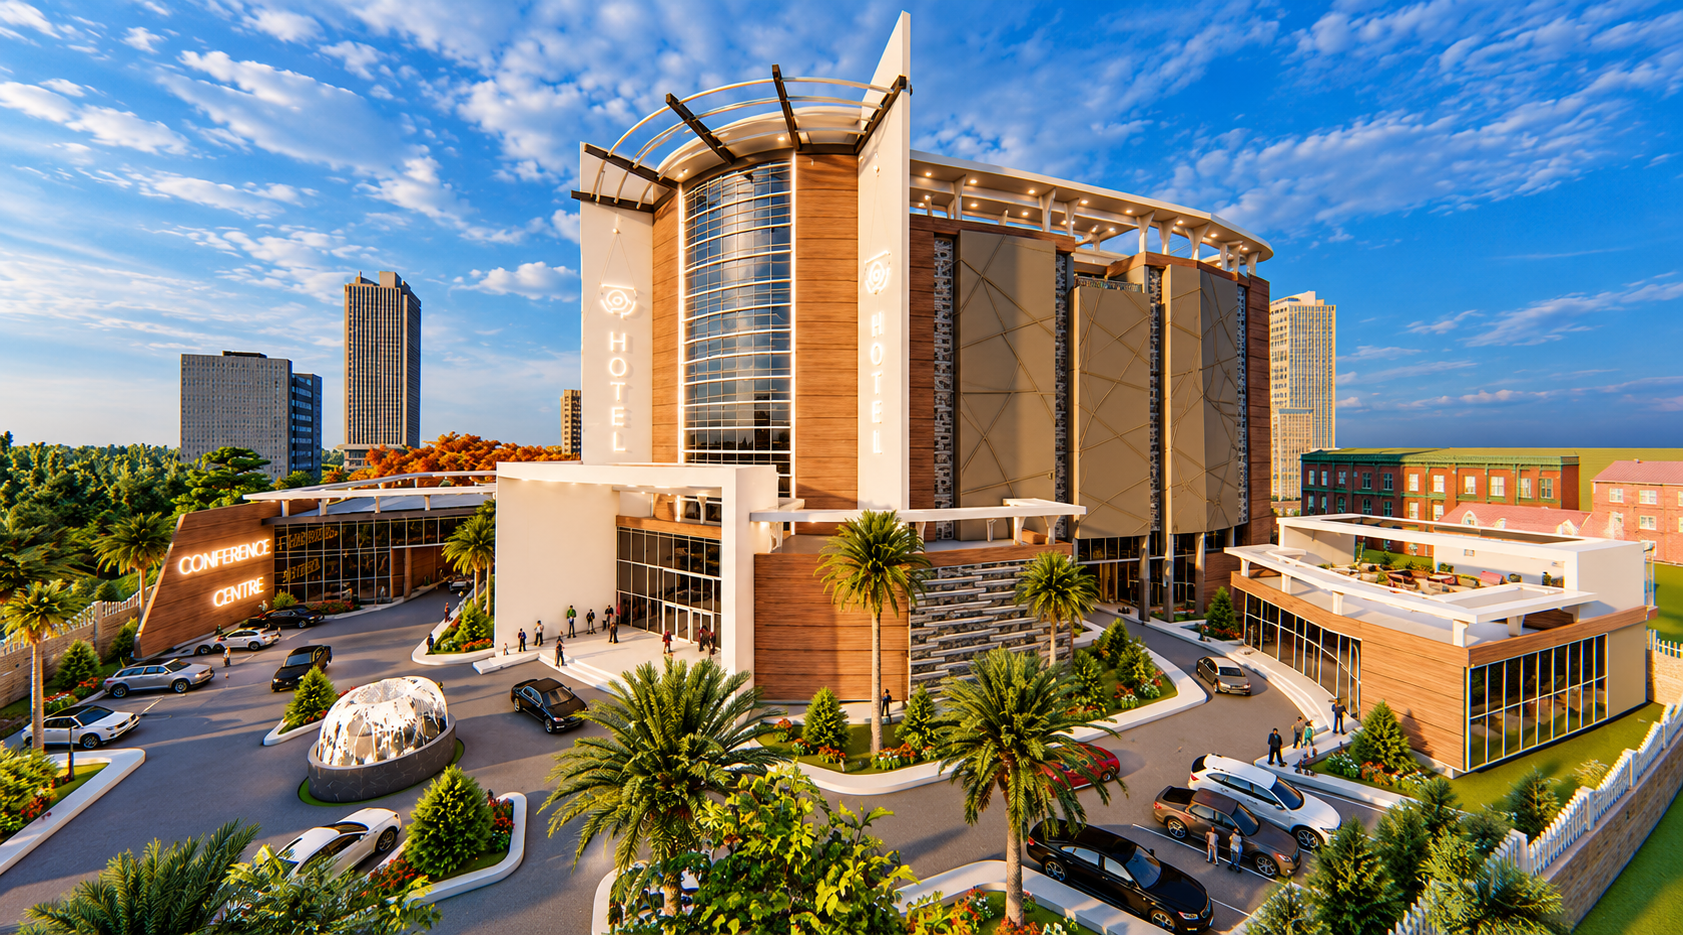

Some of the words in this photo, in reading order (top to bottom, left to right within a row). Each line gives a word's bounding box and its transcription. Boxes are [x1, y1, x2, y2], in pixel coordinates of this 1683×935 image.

[608, 331, 627, 453] HOTEL
[870, 311, 884, 455] HOTEL
[178, 538, 271, 575] CONFERENCE
[212, 576, 264, 607] CENTRE
